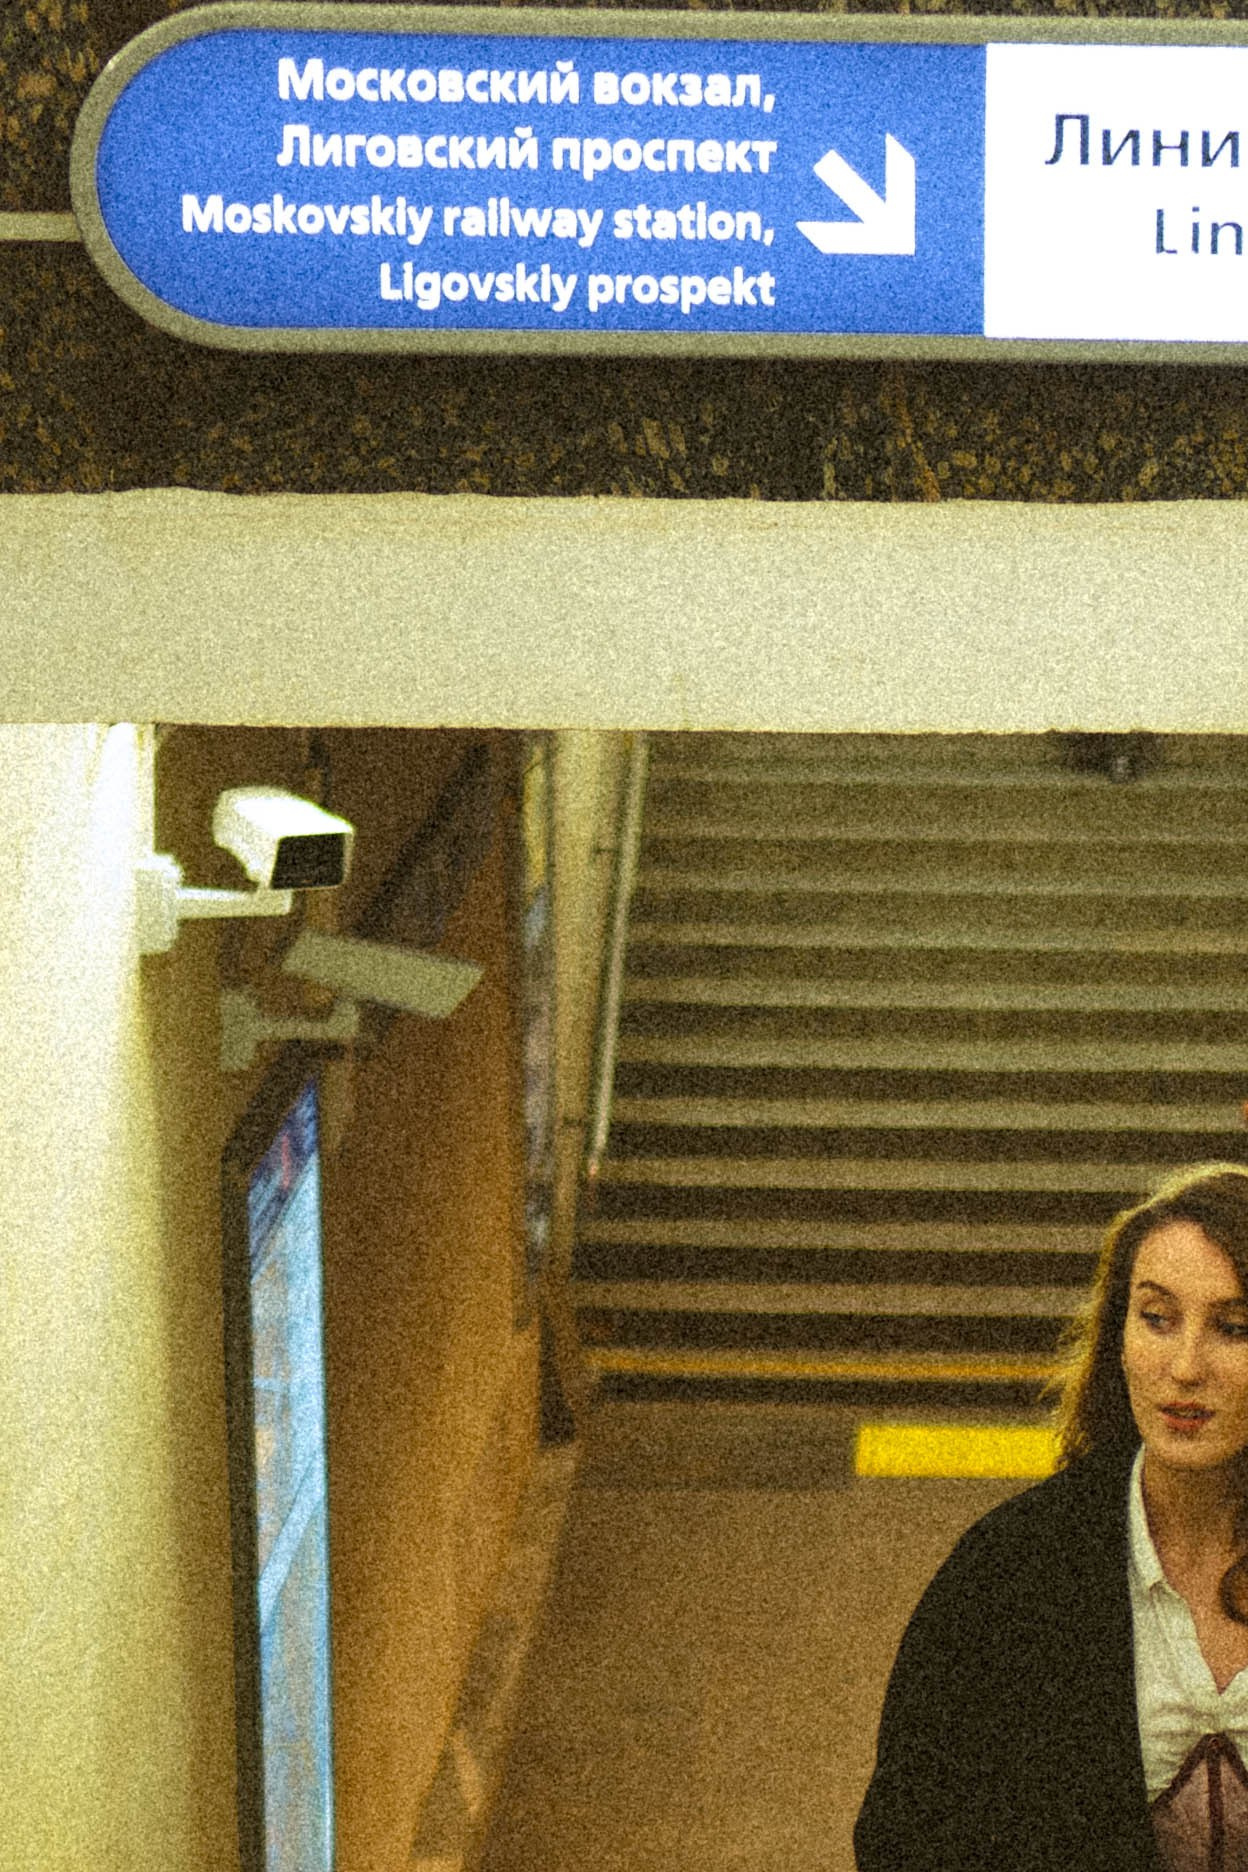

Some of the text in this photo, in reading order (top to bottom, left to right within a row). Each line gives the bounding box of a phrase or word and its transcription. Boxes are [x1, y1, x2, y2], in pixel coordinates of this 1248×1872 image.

[279, 57, 775, 113] Московский вокзал,
[277, 123, 778, 182] Лиговский проспект
[182, 193, 775, 248] Moskovskiy railway station,
[380, 261, 776, 314] Ligovskiy prospekt
